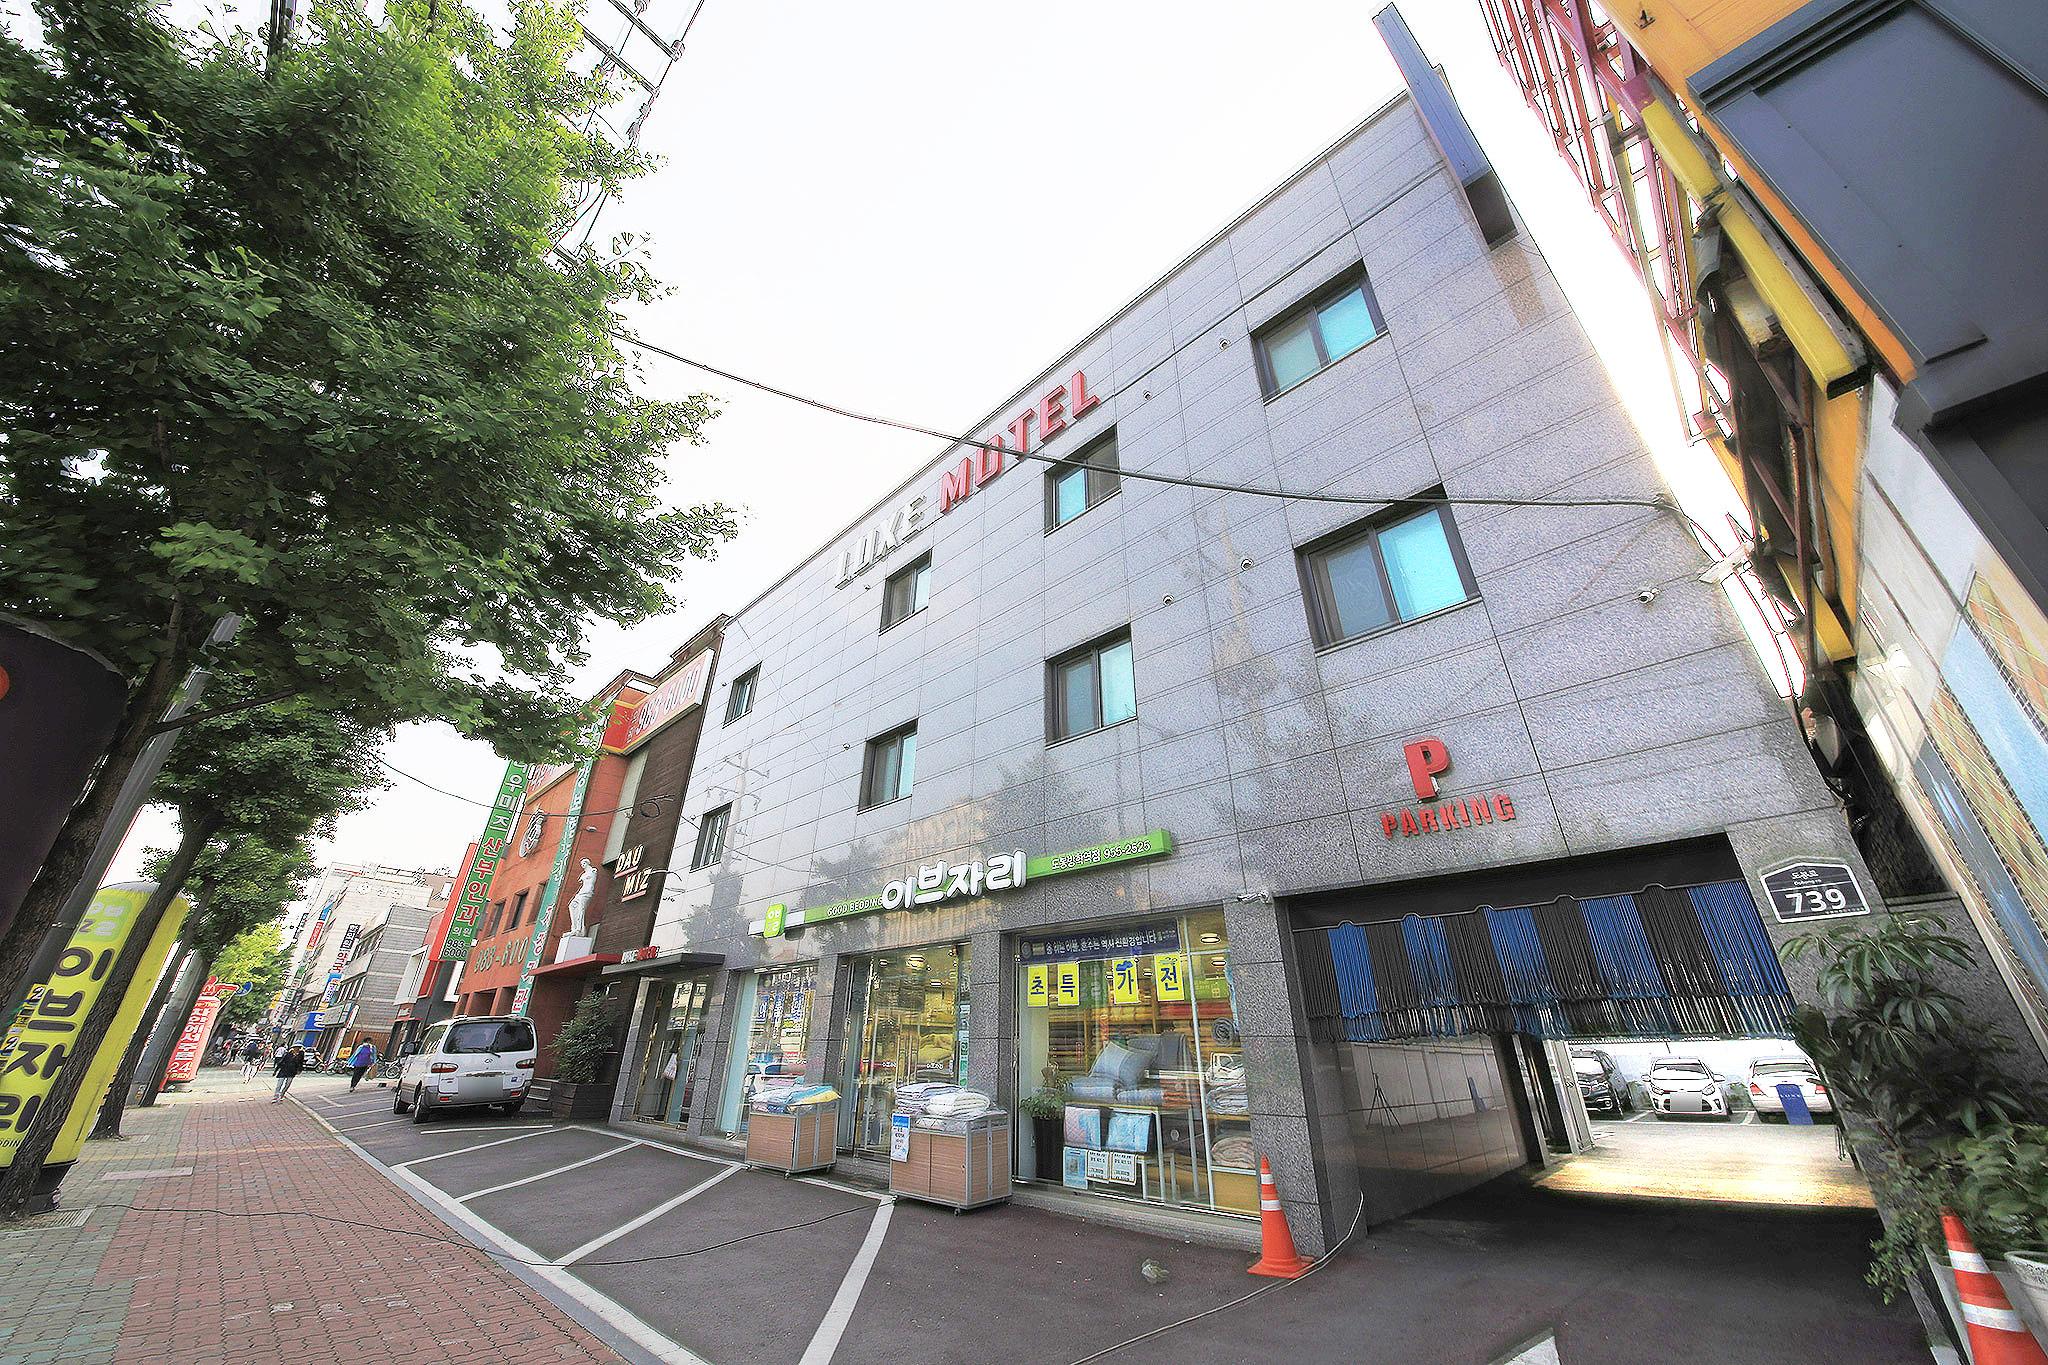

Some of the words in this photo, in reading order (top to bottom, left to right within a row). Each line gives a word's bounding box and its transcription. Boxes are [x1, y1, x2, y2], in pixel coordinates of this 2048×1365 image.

[835, 494, 927, 590] LUXE
[939, 369, 1102, 516] MOTEL
[1403, 738, 1451, 801] P
[1380, 792, 1517, 840] PARKING
[614, 843, 645, 875] DAU
[1103, 838, 1152, 860] 955-2525
[456, 836, 504, 926] 산부인과
[622, 867, 654, 897] MIZ
[881, 849, 1028, 911] 이브자리
[826, 903, 848, 917] GOOD
[849, 896, 884, 912] BEDDING
[1784, 888, 1847, 914] 739
[443, 947, 468, 958] 6000
[0, 946, 116, 1134] 이브자리
[168, 1061, 193, 1073] 24
